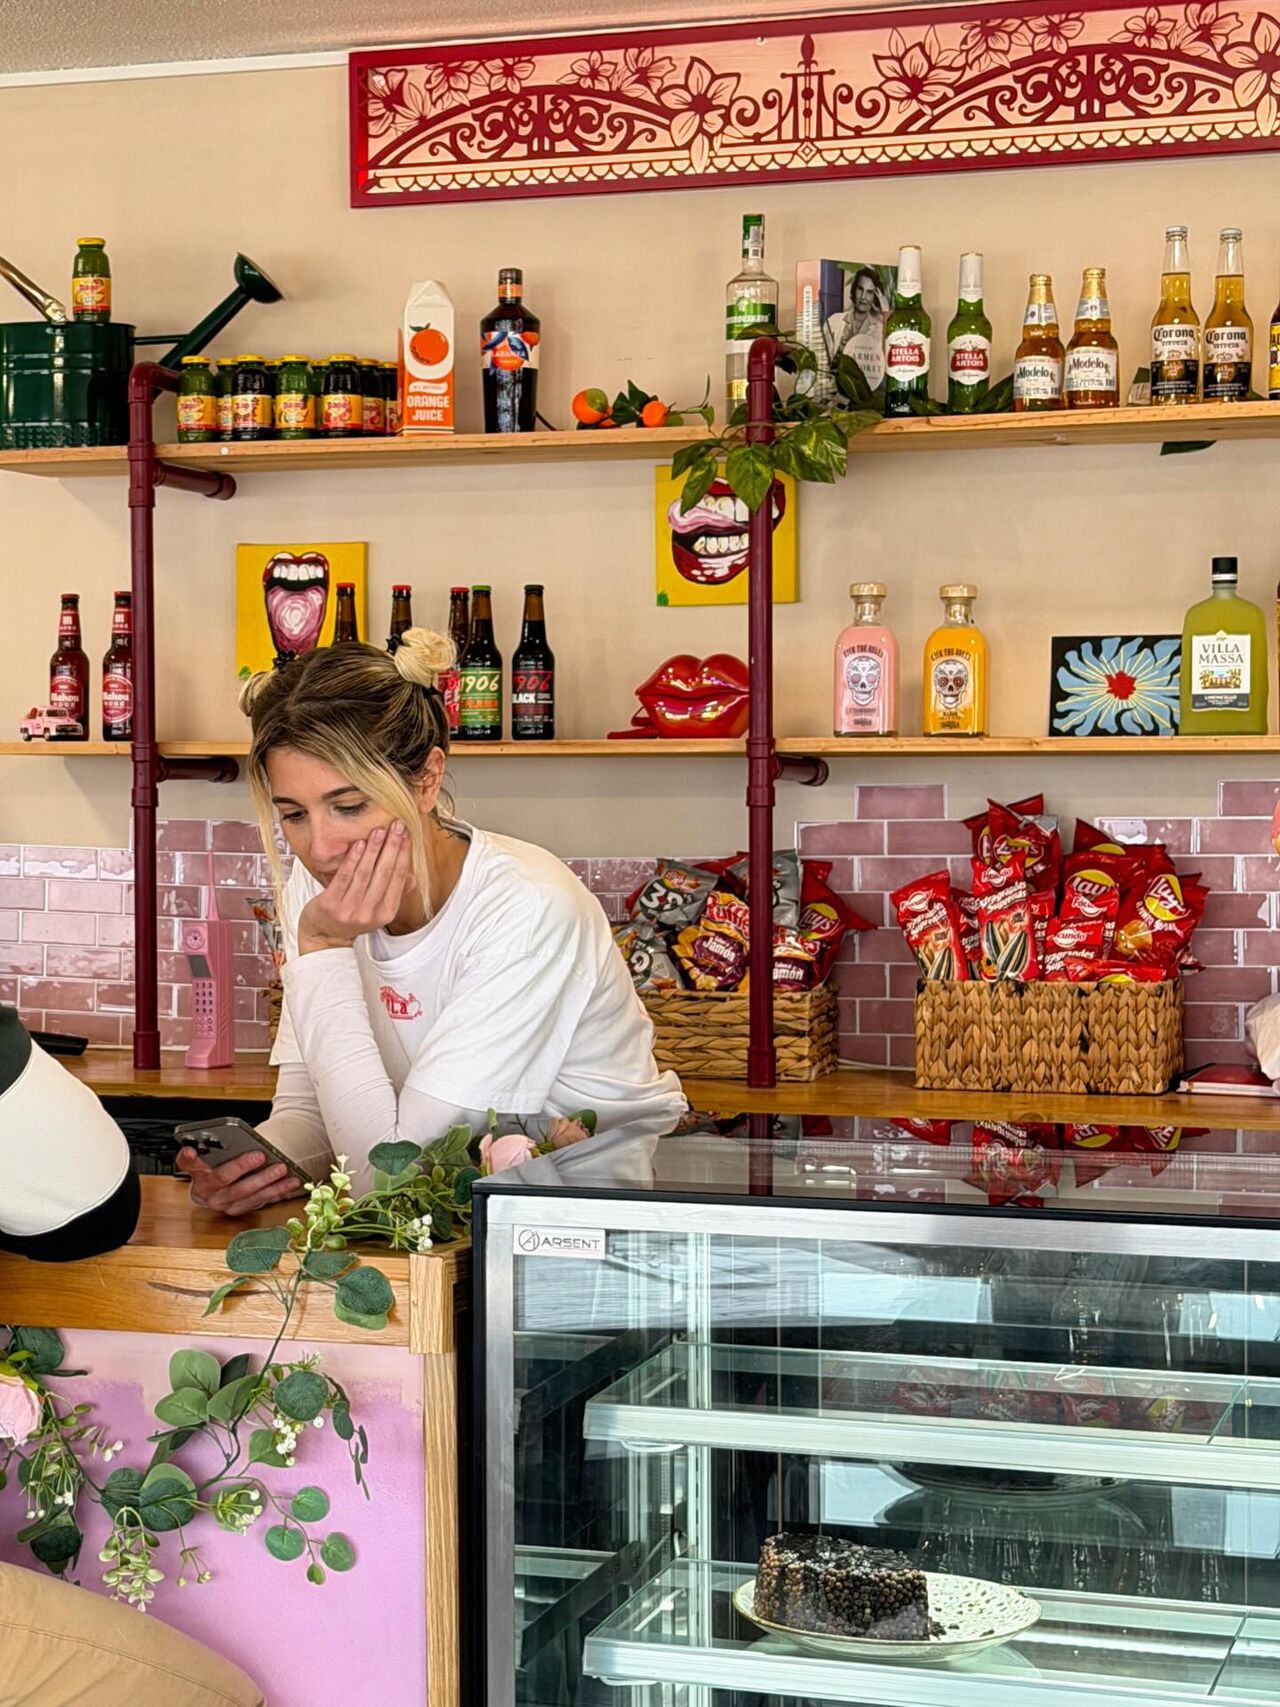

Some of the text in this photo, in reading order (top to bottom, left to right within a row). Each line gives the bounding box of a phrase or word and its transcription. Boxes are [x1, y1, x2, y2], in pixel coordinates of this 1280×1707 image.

[1153, 328, 1196, 341] Corona
[1206, 330, 1248, 344] Corona
[892, 347, 920, 355] STELLA
[956, 352, 984, 360] STELLA
[1071, 358, 1105, 370] Modelo
[1017, 367, 1050, 379] Modelo
[407, 395, 450, 408] ORANGE
[412, 409, 444, 421] JUICE
[1202, 643, 1241, 653] VILLA
[1199, 654, 1244, 664] MASSA
[460, 674, 500, 692] 1906
[703, 936, 736, 962] Jamón
[773, 966, 804, 981] amón
[541, 1236, 601, 1249] ARSENT
